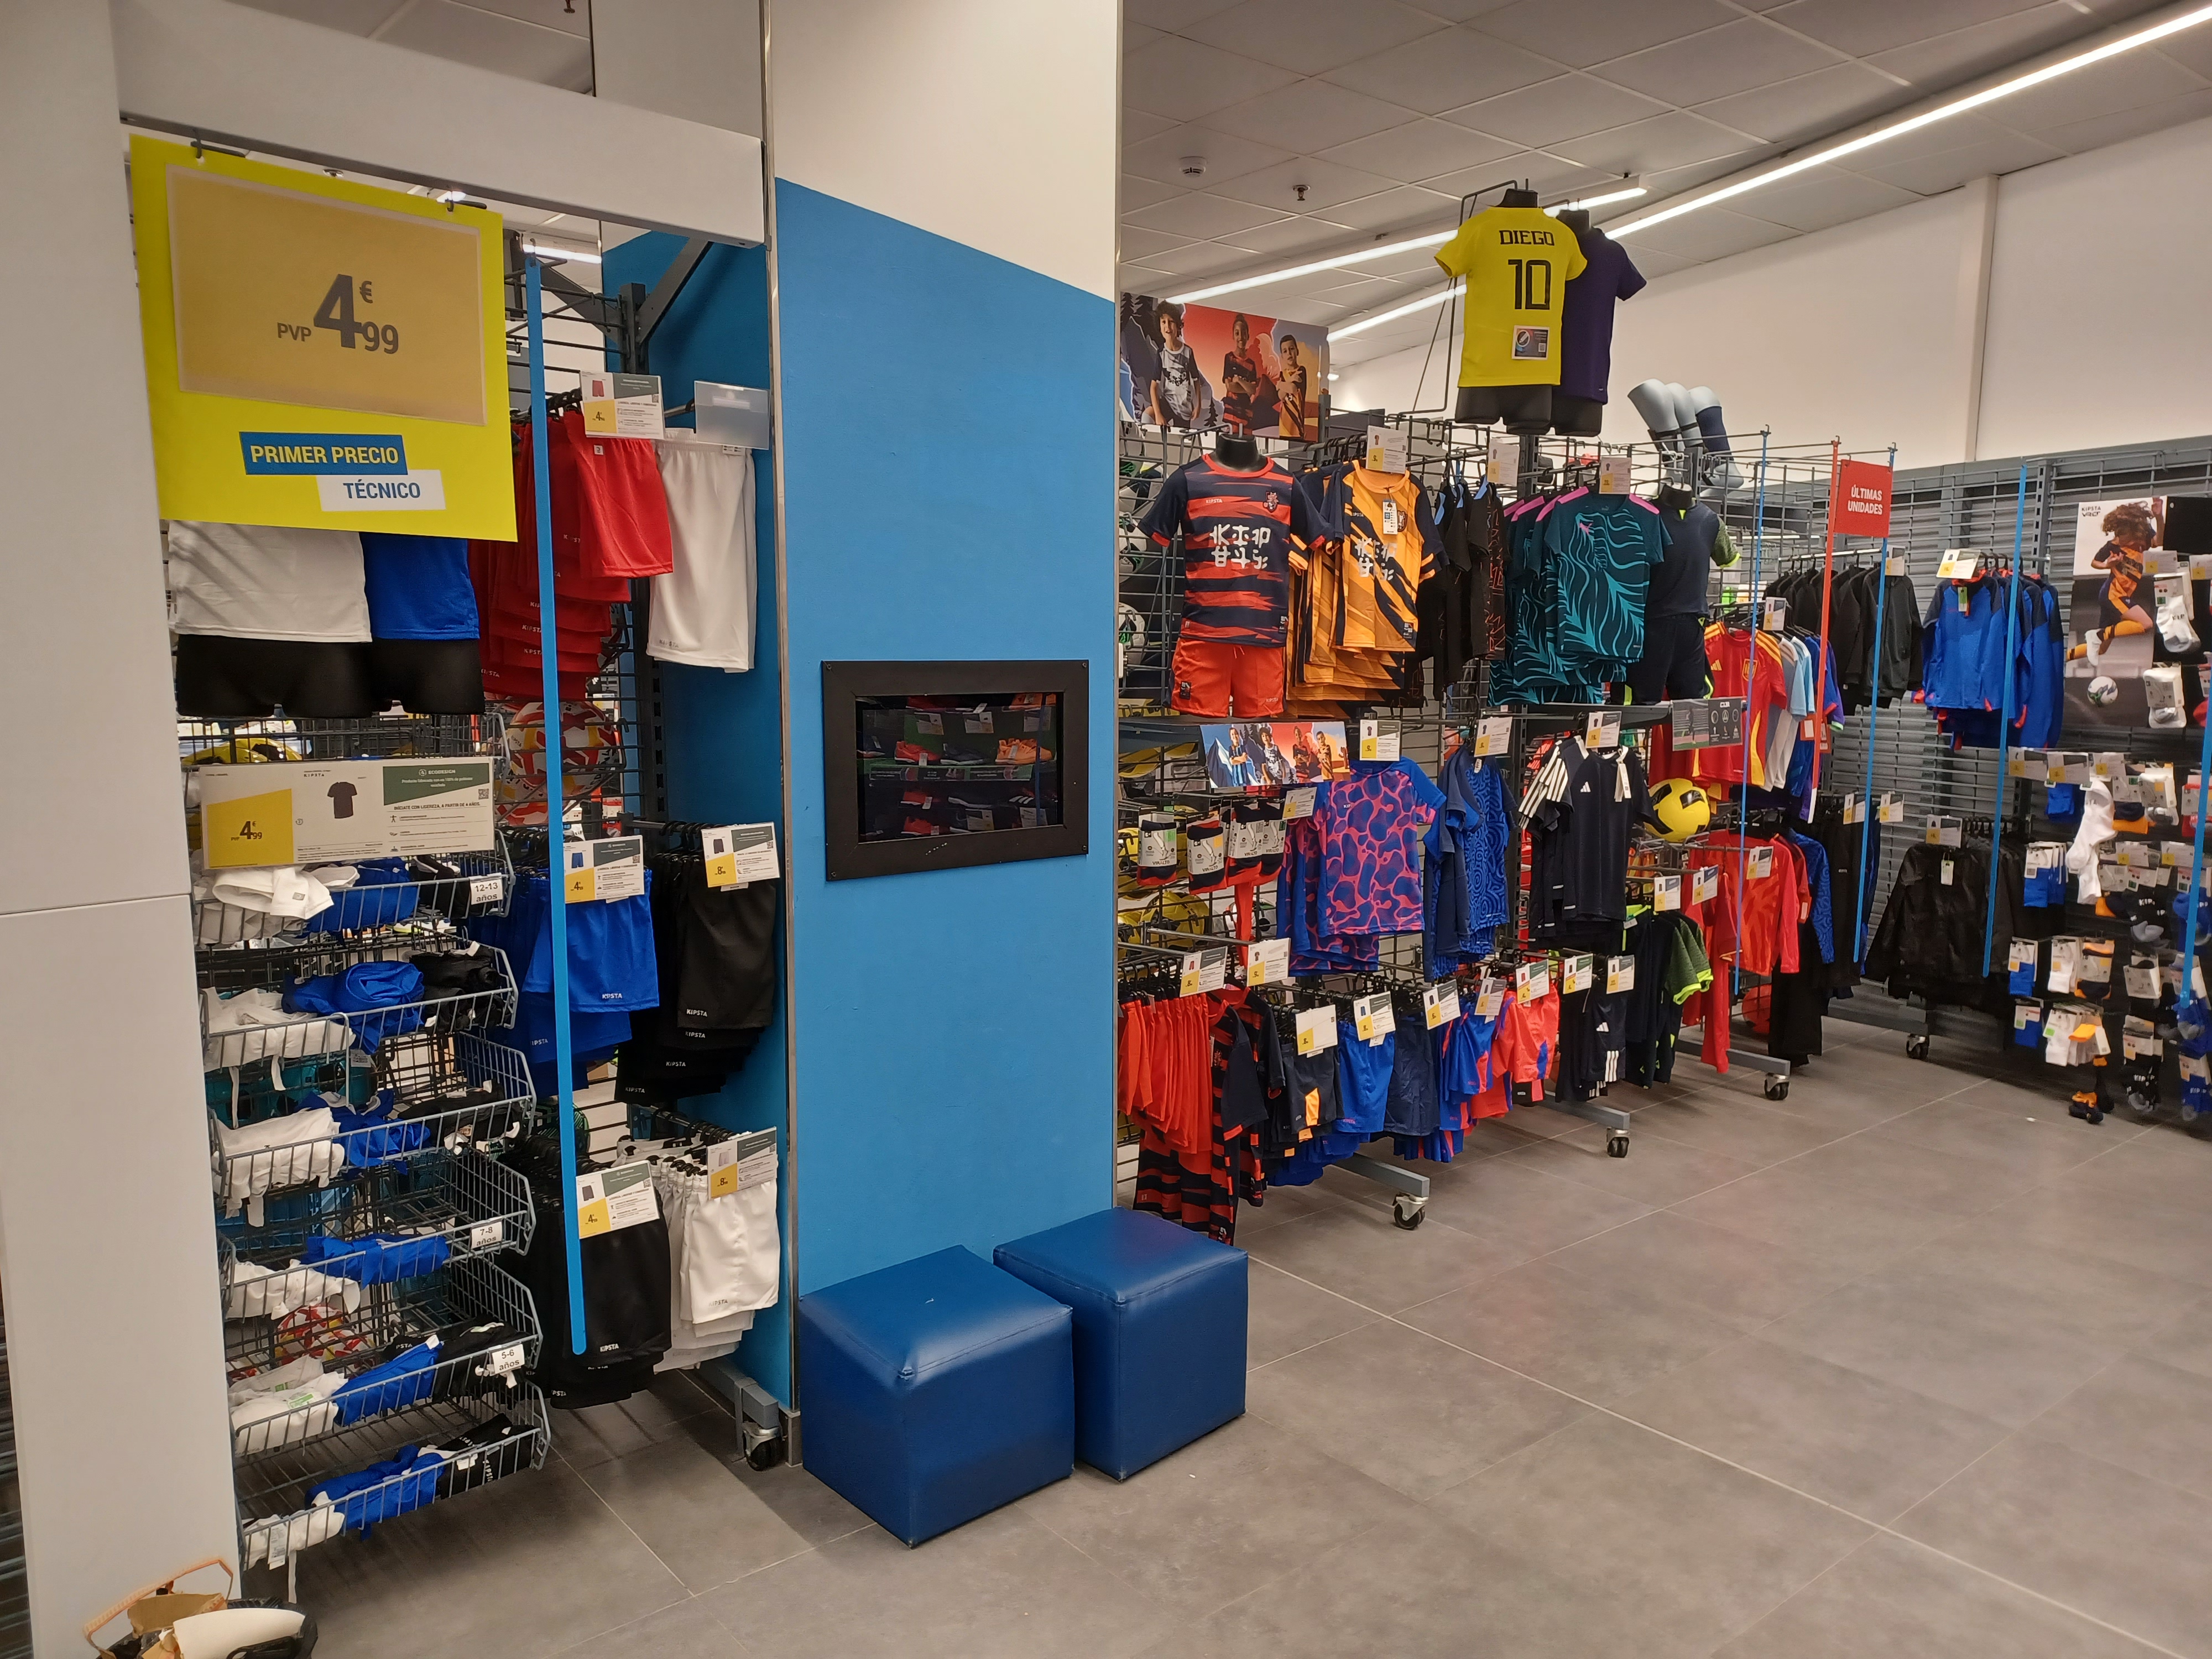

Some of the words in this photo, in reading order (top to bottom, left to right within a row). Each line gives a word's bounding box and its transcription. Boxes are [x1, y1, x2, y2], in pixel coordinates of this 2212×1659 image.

[1499, 230, 1554, 246] DIEGO
[1507, 259, 1552, 310] 10
[277, 323, 311, 342] PVP
[251, 445, 327, 464] PRIMER
[331, 446, 399, 464] PRECIO
[343, 479, 420, 499] TÉCNICO
[1851, 484, 1882, 501] ÚLTIMAS
[1848, 500, 1882, 515] UNIDADES
[474, 883, 498, 893] 12-13
[476, 894, 497, 902] años
[686, 1008, 707, 1017] KIPSTA
[685, 1030, 705, 1039] KIPSTA
[480, 1227, 493, 1235] 7-8
[477, 1237, 497, 1246] años
[599, 1343, 619, 1352] KIPSTA
[502, 1350, 514, 1359] 5-6
[499, 1360, 519, 1371] años
